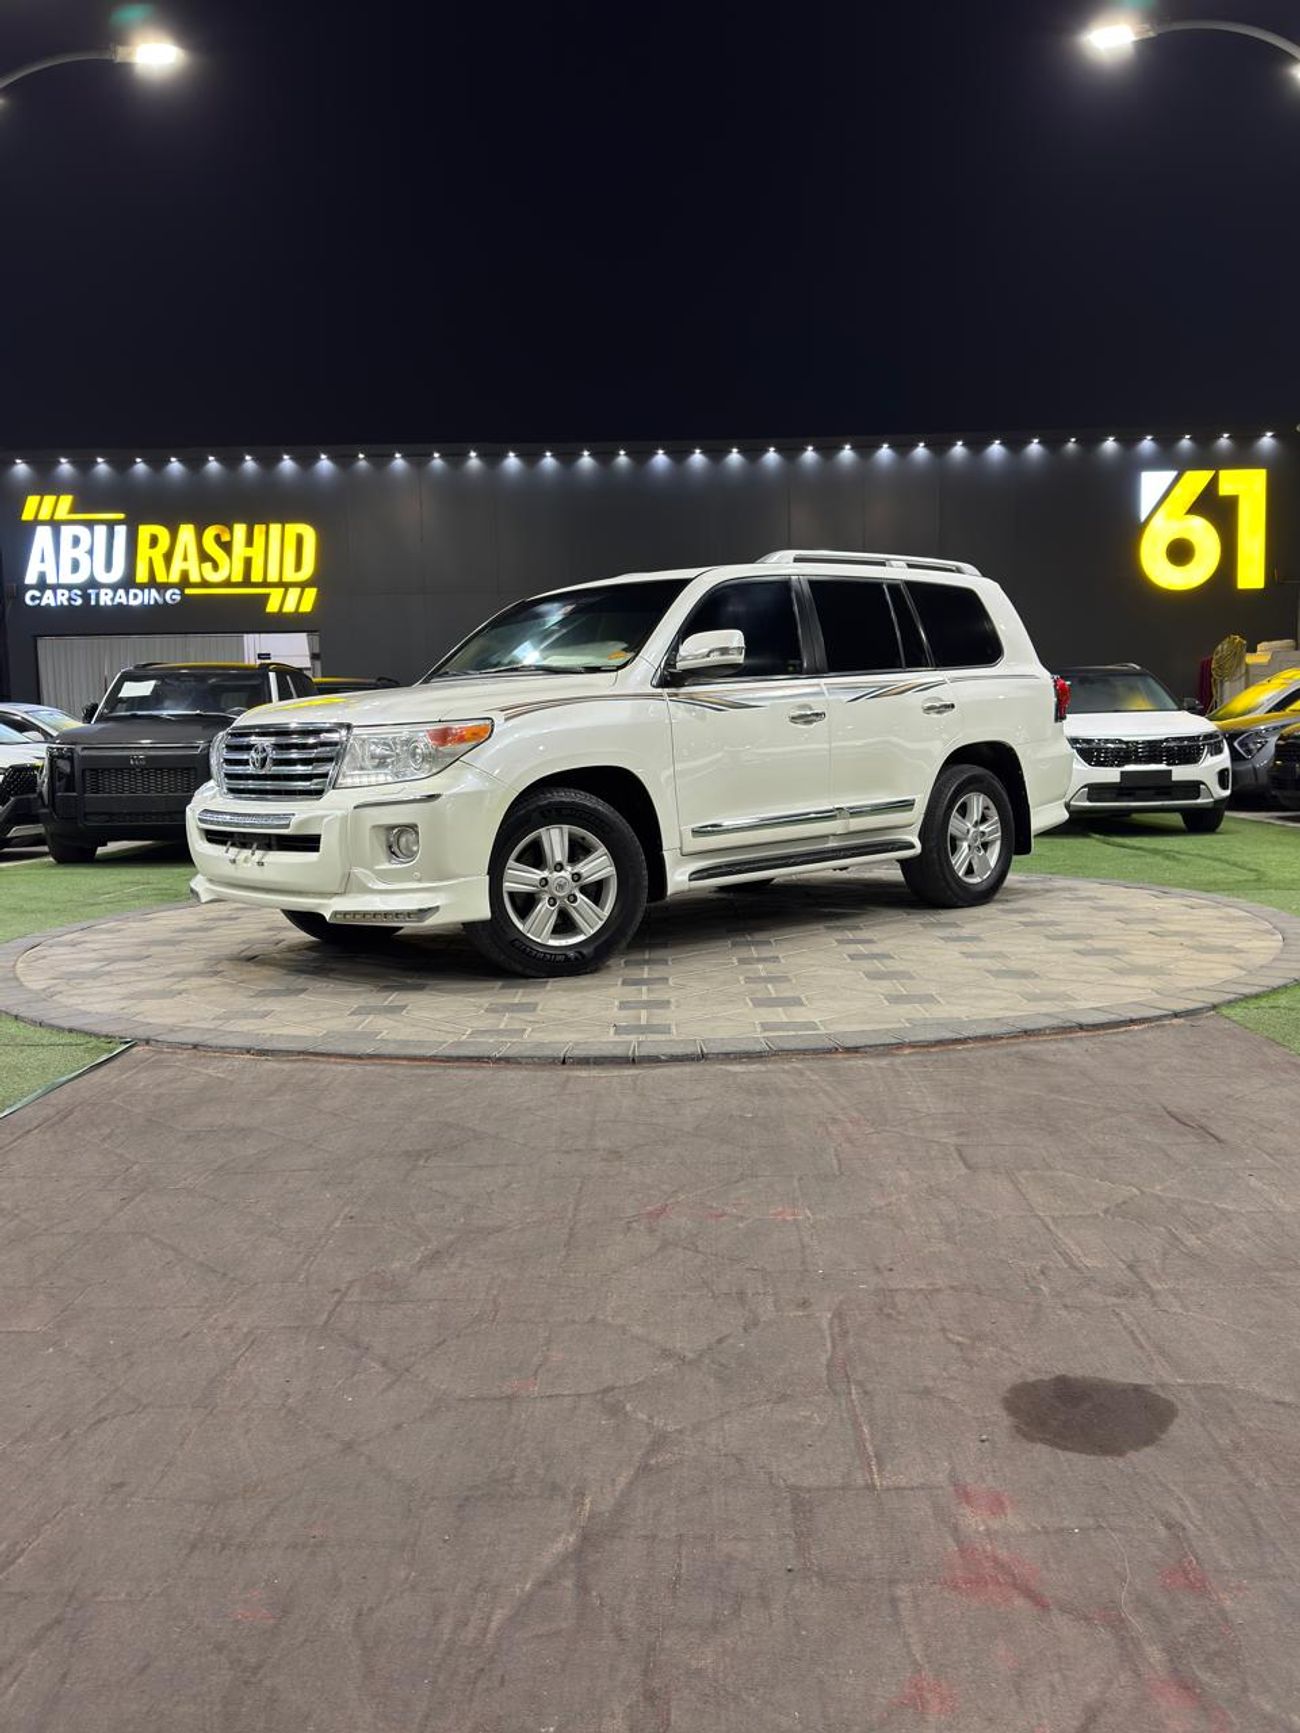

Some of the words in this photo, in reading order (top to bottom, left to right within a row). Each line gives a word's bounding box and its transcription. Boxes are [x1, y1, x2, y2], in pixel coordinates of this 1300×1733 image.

[24, 524, 127, 584] ABU
[135, 523, 317, 583] RASHID
[1139, 469, 1267, 591] 61
[24, 588, 82, 606] CARS
[87, 587, 182, 605] TRADING
